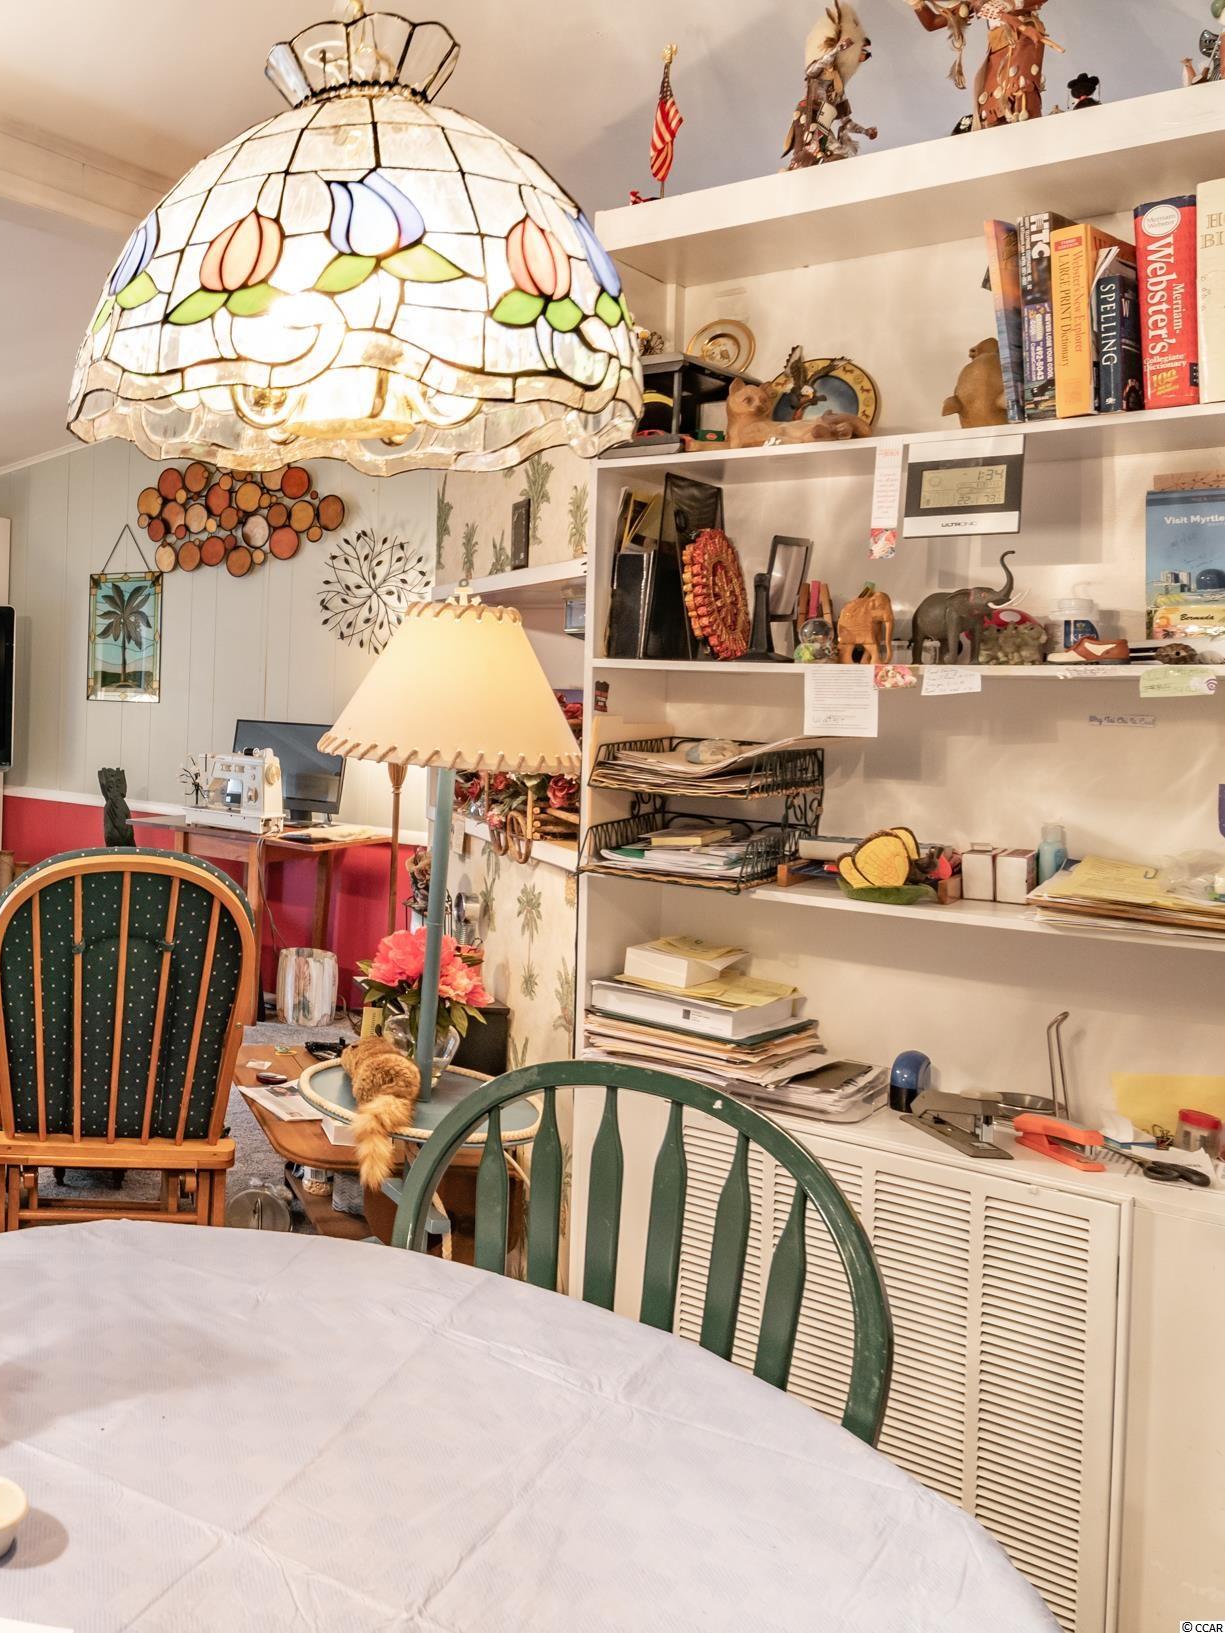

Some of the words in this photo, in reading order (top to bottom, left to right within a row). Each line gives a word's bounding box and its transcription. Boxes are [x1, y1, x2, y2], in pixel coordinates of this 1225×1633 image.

[1030, 212, 1051, 259] HTC
[1058, 253, 1071, 287] LARGE
[1073, 250, 1085, 294] Webster's
[1060, 287, 1072, 322] PRINT
[1074, 293, 1085, 314] New
[1147, 234, 1178, 355] Webster's
[1172, 283, 1186, 334] Merriam-
[1074, 315, 1087, 353] Explorer
[1099, 283, 1118, 366] SPELLING
[1061, 322, 1072, 368] Dictionary
[1144, 353, 1186, 365] Collegiate
[1164, 515, 1188, 525] Visit
[1190, 513, 1225, 526] Myrtle
[1180, 612, 1214, 621] Bermuda
